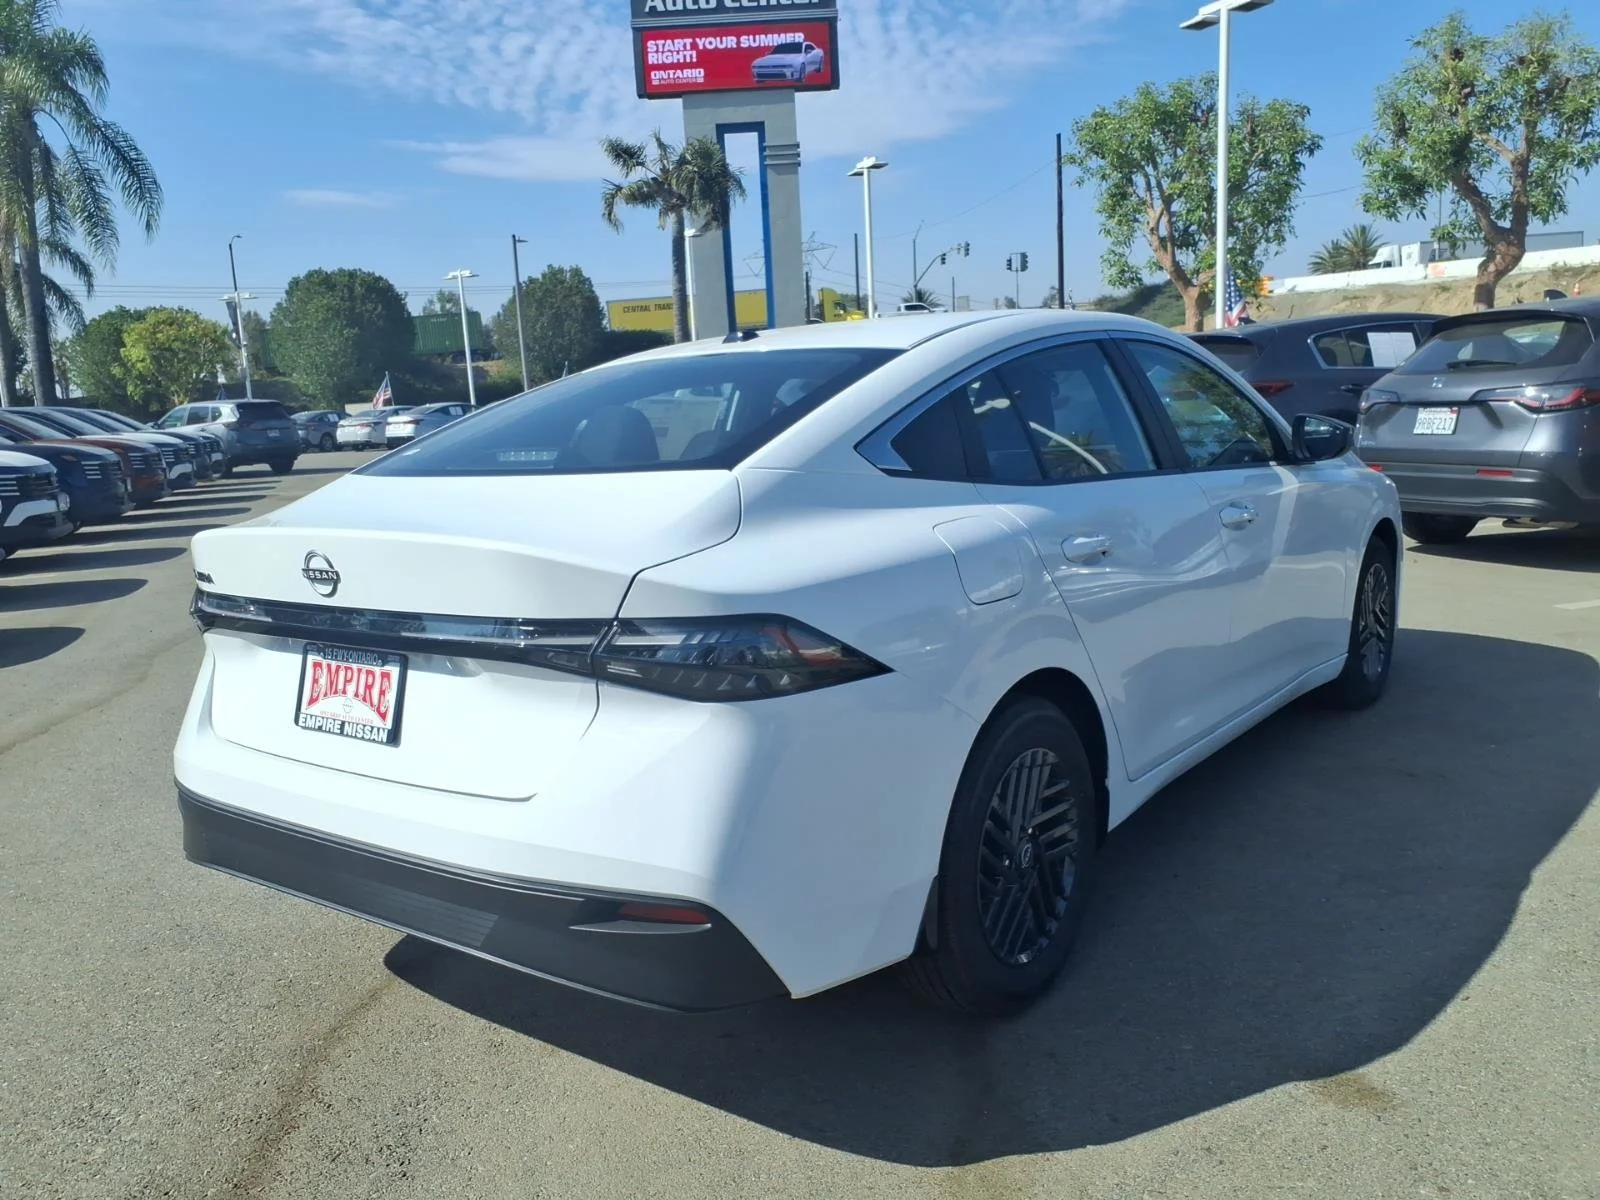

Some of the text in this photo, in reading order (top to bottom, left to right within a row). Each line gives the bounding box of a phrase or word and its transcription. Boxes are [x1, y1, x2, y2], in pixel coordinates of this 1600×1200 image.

[647, 32, 804, 52] START YOUR SUMMER
[648, 50, 697, 65] RIGHT!
[651, 68, 704, 80] ONTARIO
[623, 305, 651, 313] CENTRAL
[305, 658, 393, 726] EMPIRE
[298, 713, 341, 734] EMPIRE
[343, 721, 388, 743] NISSAN
